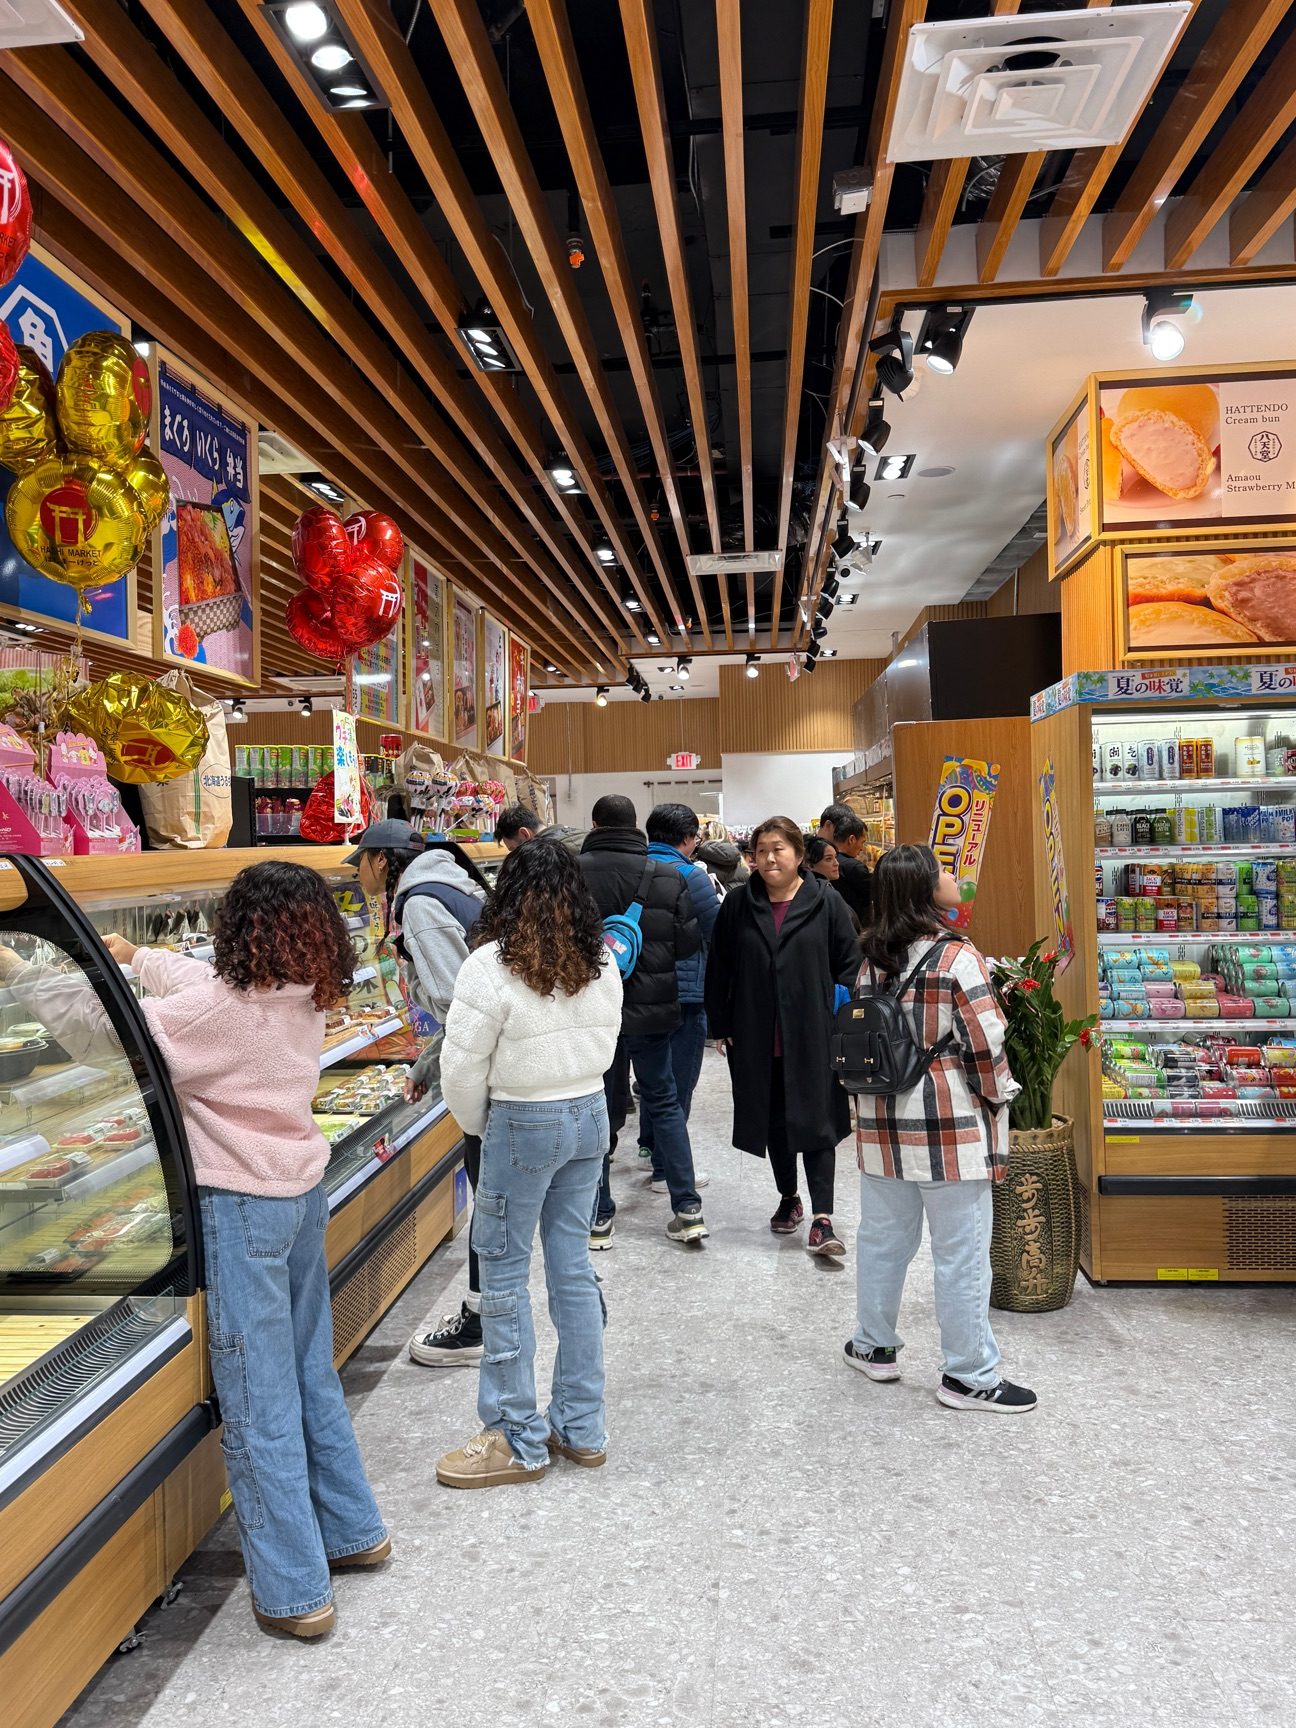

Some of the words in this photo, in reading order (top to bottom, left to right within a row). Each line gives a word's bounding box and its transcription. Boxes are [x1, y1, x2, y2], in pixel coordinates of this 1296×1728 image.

[1225, 403, 1288, 414] HATTENDO
[1225, 416, 1258, 425] Cream
[1261, 415, 1280, 423] bun
[163, 404, 190, 453] まぐろ
[196, 430, 220, 471] いくら
[226, 447, 244, 489] 弁当
[1259, 433, 1272, 460] 八天堂
[1226, 474, 1261, 482] Amaou
[1226, 483, 1282, 493] Strawberry
[67, 548, 102, 558] MARKET
[1112, 674, 1184, 697] 夏の味覚
[1255, 669, 1296, 691] 夏の
[675, 753, 693, 768] EXIT
[932, 784, 972, 877] OPE
[963, 799, 987, 867] リニューアル
